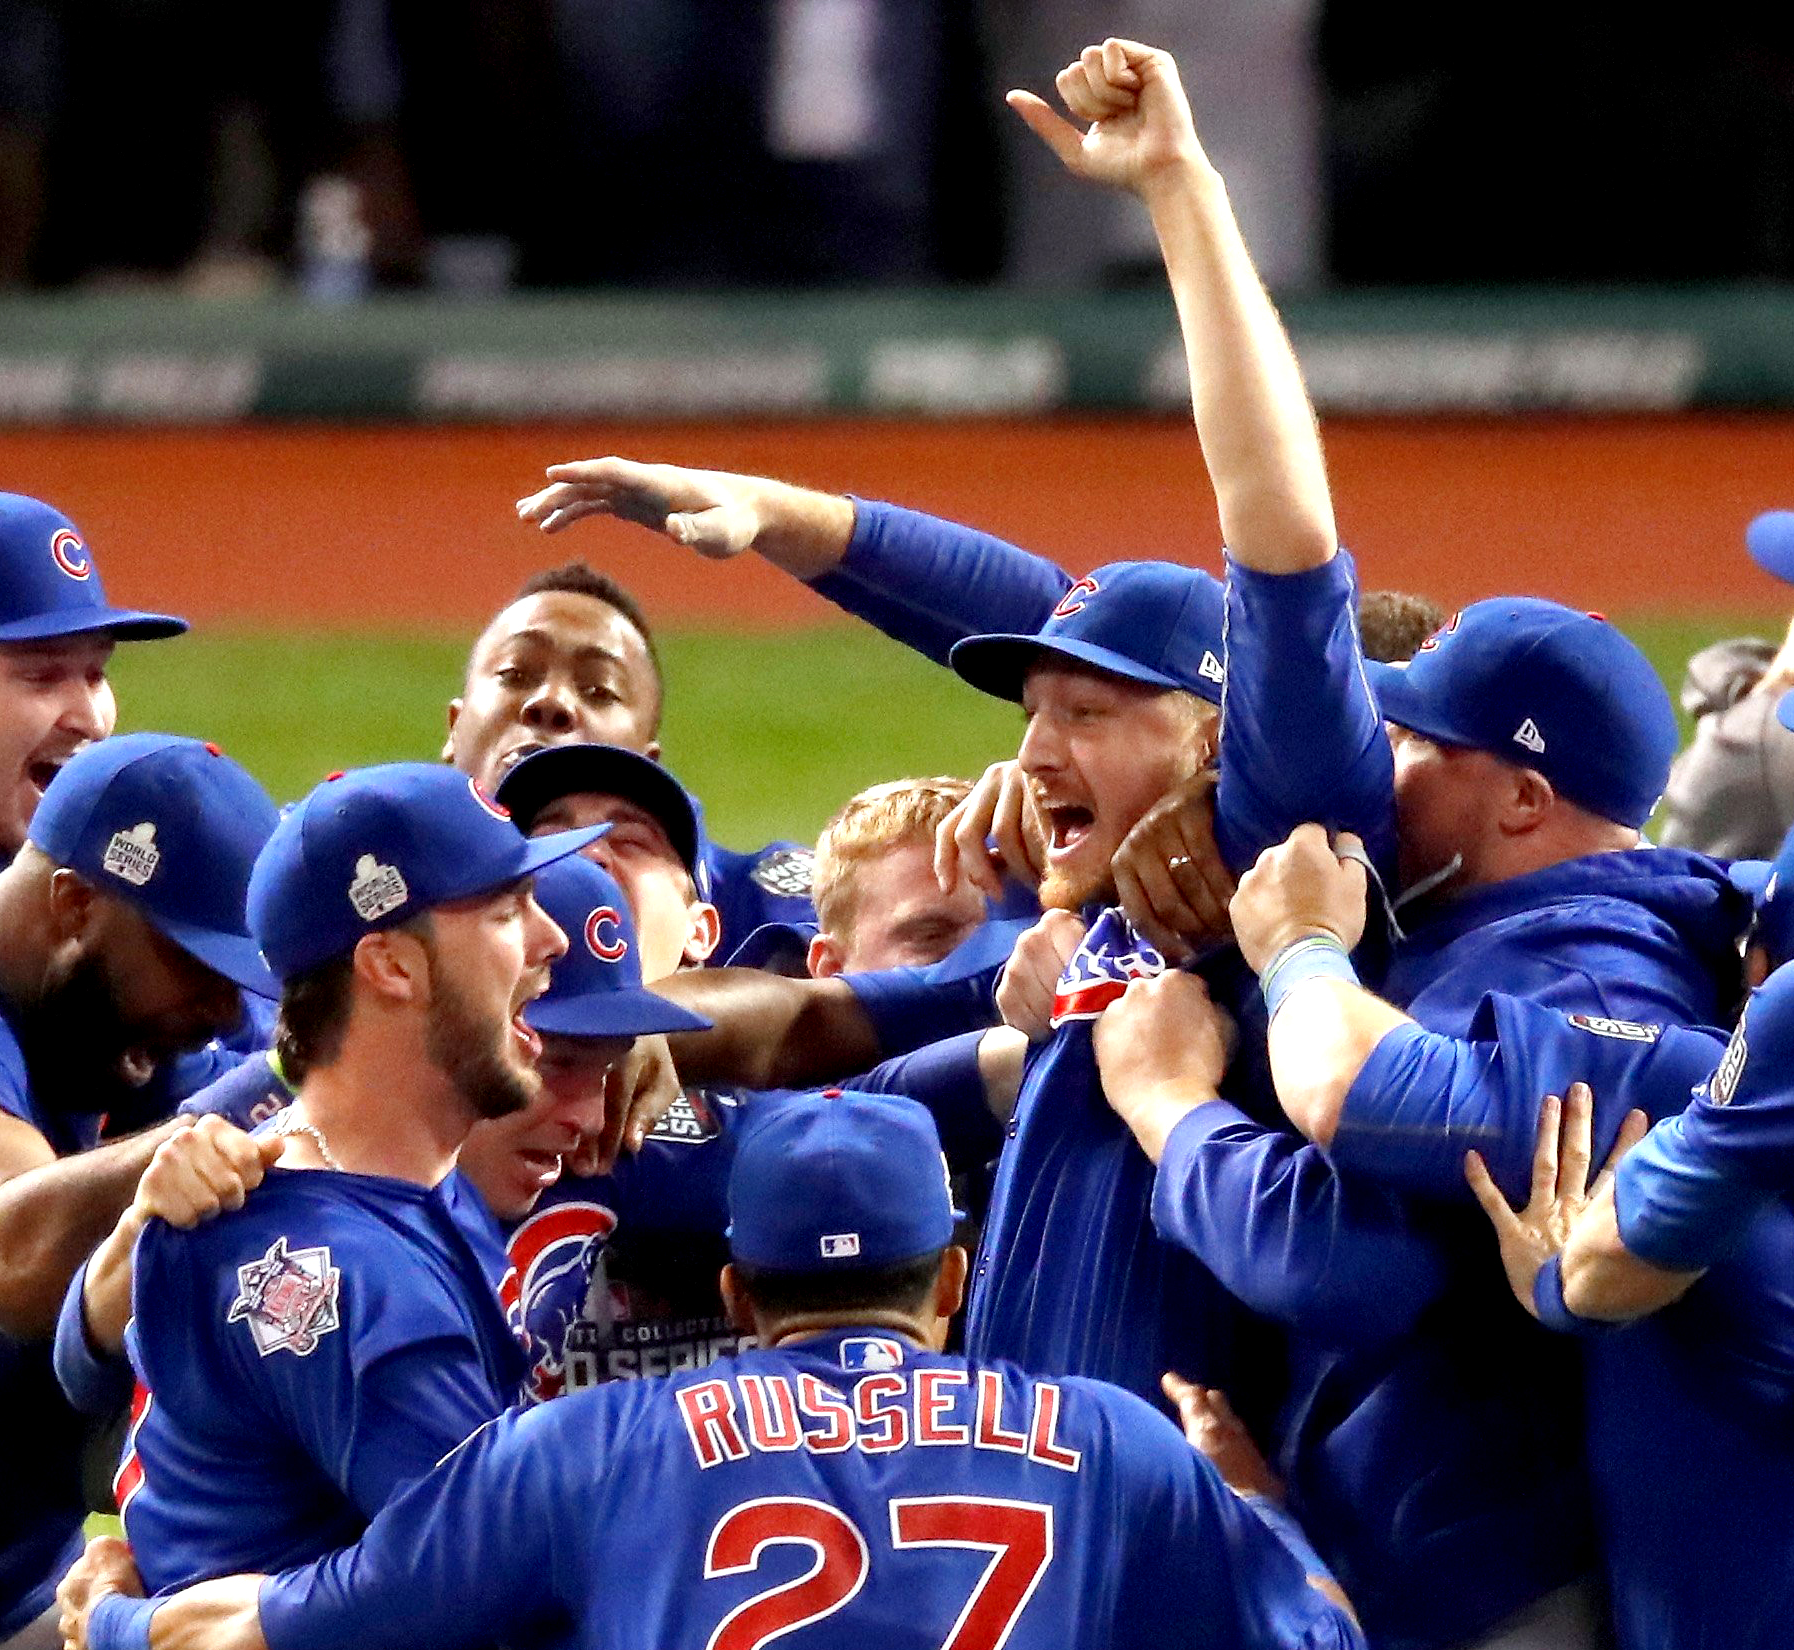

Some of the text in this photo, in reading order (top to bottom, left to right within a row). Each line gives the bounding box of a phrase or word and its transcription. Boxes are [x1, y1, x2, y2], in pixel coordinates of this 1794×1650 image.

[50, 527, 92, 581] C
[108, 847, 152, 878] SERIES
[114, 836, 157, 864] WORLD
[583, 904, 629, 962] C
[675, 1369, 1082, 1472] RUSSELL
